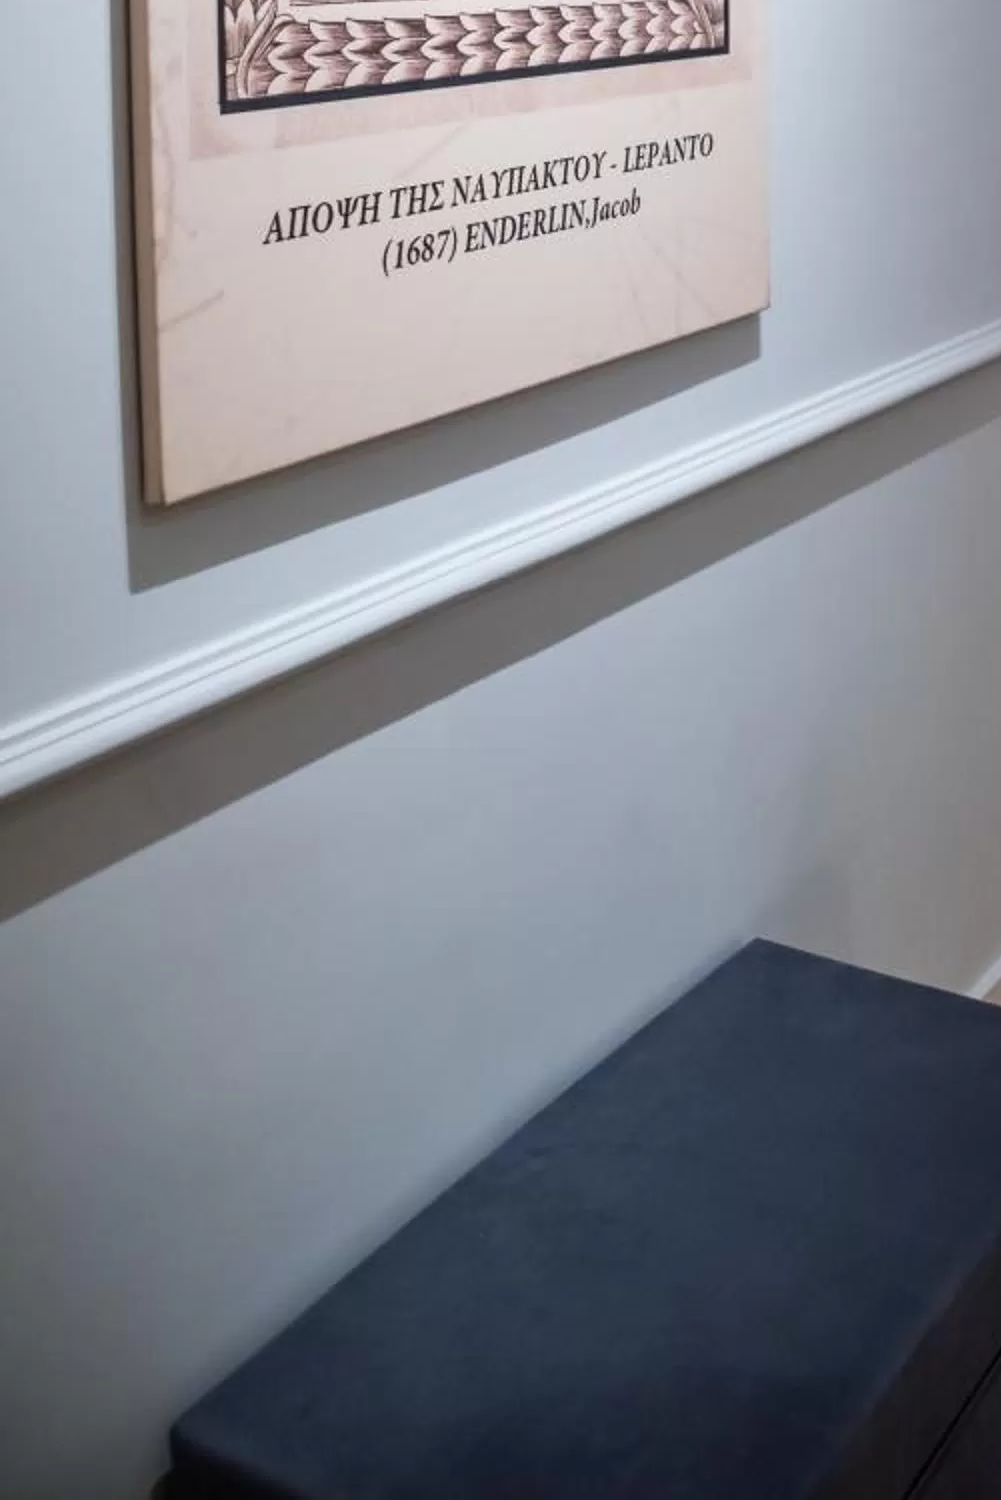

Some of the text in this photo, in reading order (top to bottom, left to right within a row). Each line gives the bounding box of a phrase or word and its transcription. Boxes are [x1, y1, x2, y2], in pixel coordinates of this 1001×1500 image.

[263, 191, 381, 245] ΑΠΟΨΗ
[390, 179, 445, 219] ΤΗΣ
[451, 151, 607, 208] ΝΑΥΠΑΚΤΟΥ
[623, 132, 714, 174] LEPANTO
[382, 229, 458, 277] (1687)
